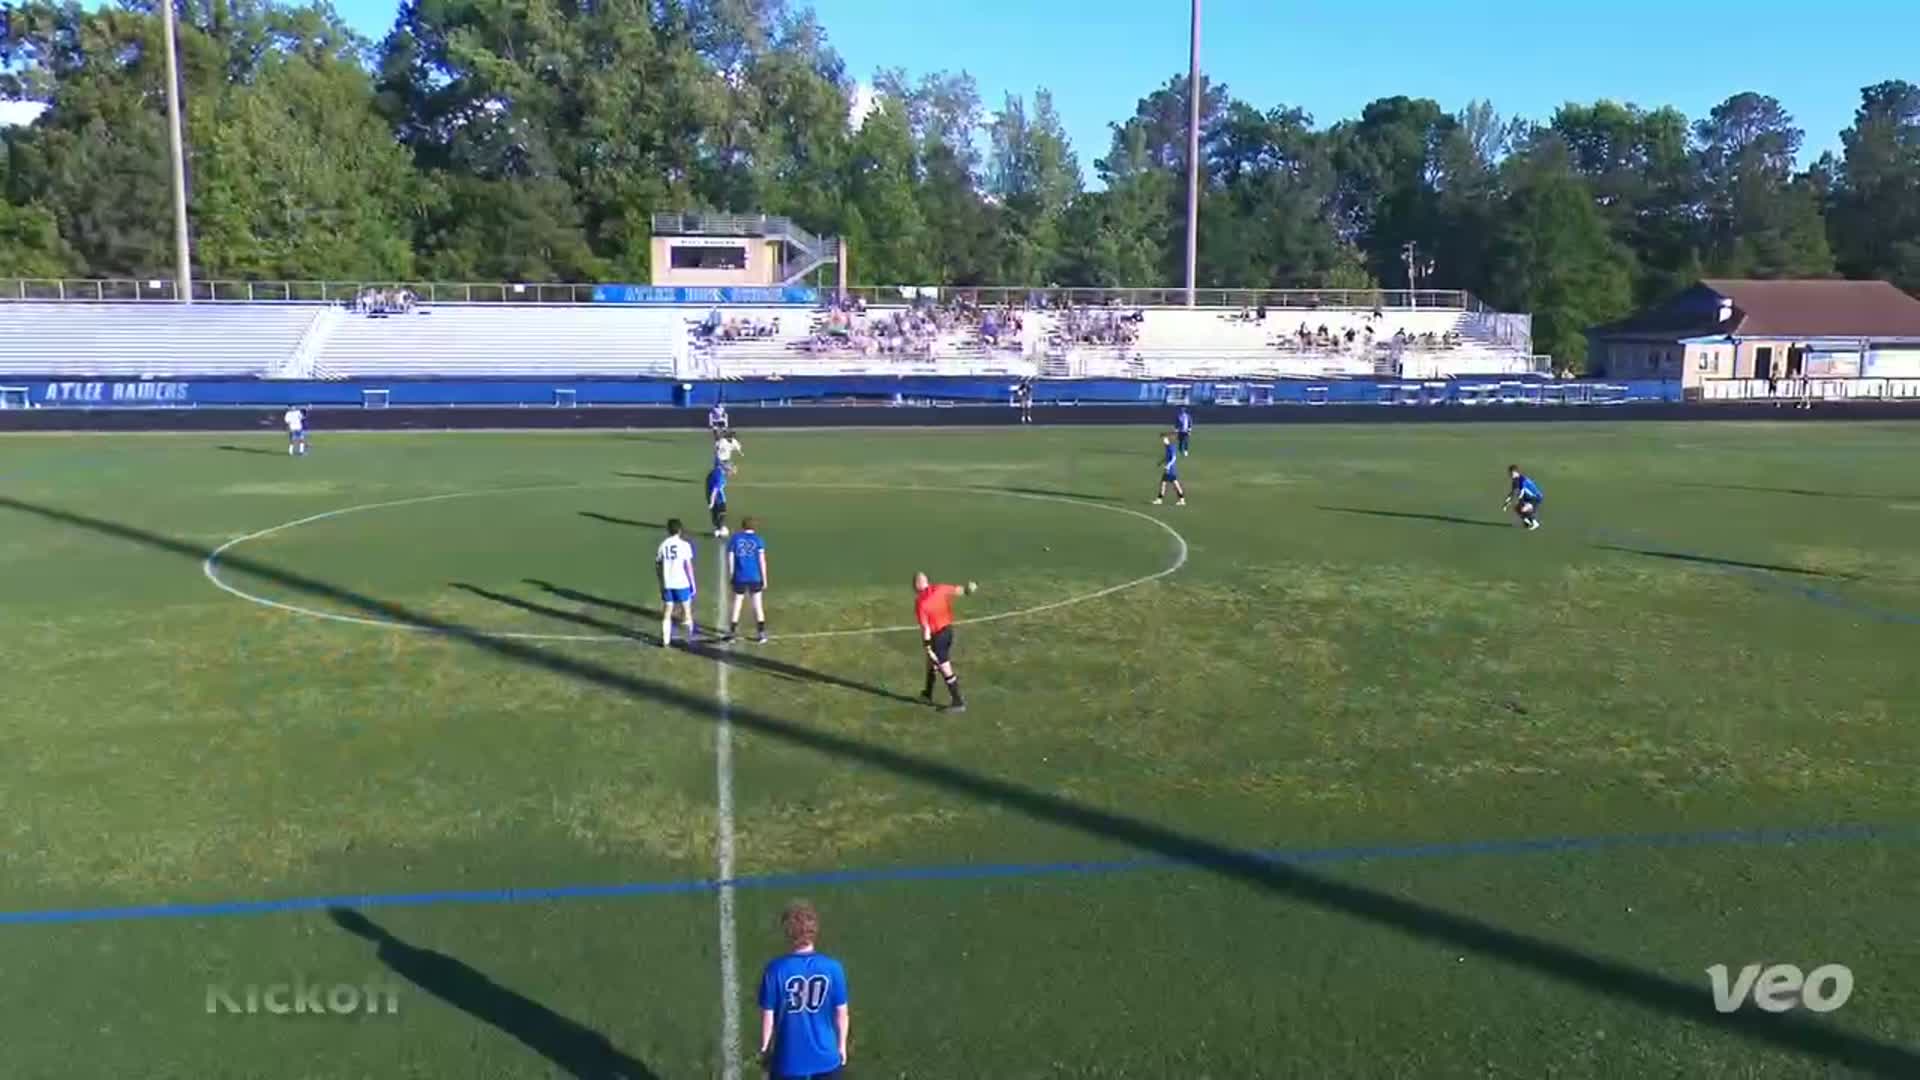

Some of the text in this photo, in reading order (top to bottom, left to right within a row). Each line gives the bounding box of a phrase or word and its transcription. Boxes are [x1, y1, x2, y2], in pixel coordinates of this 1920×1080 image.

[45, 382, 189, 400] ATLEE RAIDERS
[664, 545, 678, 560] 15
[785, 974, 829, 1014] 30
